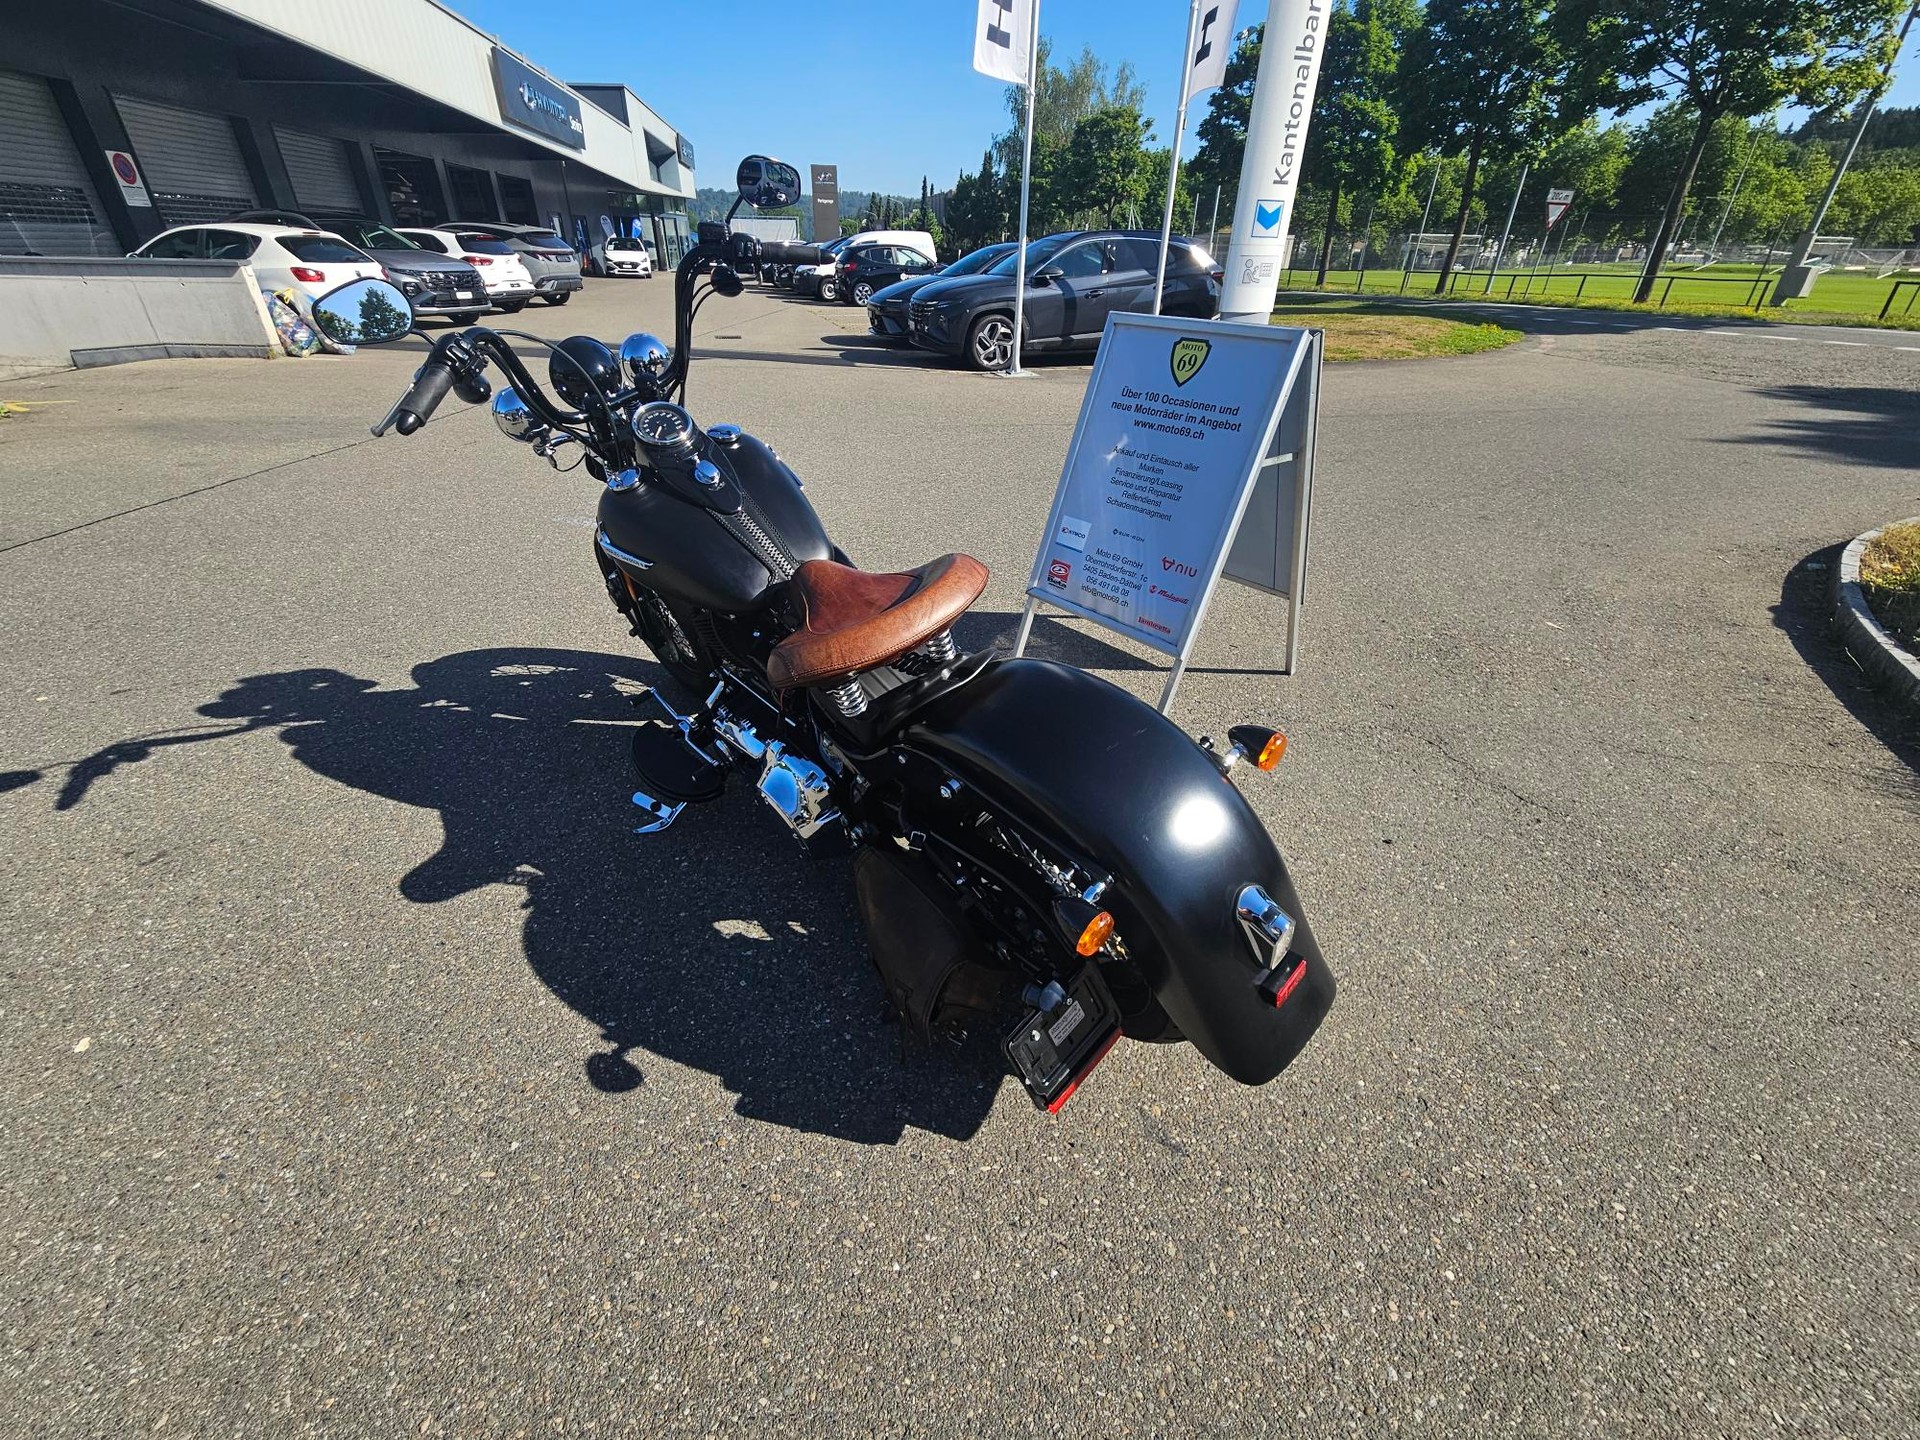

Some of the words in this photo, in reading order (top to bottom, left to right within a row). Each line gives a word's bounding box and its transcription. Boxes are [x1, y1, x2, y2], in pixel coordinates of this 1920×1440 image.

[1181, 343, 1203, 351] MOTO
[1177, 352, 1198, 372] 69
[1121, 385, 1142, 400] Über
[1144, 391, 1160, 403] 100
[1161, 394, 1217, 413] Occasionen
[1218, 405, 1240, 416] und
[1111, 401, 1133, 412] neue
[1133, 403, 1184, 421] Motorräder
[1184, 412, 1197, 424] im
[1198, 415, 1242, 433] Angebot
[1133, 419, 1205, 441] www.moto69.ch
[1136, 453, 1150, 461] und
[1150, 453, 1183, 469] Eintausch
[1183, 462, 1200, 472] aller
[1139, 462, 1165, 475] Marken
[1110, 477, 1134, 490] Service
[1134, 484, 1148, 493] und
[1148, 486, 1182, 502] Reparatur
[1115, 467, 1184, 493] Finanzierung/Leasing
[1106, 496, 1172, 522] Schadenmanagment
[1122, 490, 1162, 507] Reifendienst
[1083, 563, 1098, 575] 5405
[1096, 548, 1111, 559] Moto
[1112, 553, 1121, 562] 69
[1121, 556, 1144, 570] GmbH
[1081, 583, 1129, 607] info@moto69.ch
[1098, 580, 1110, 590] 491
